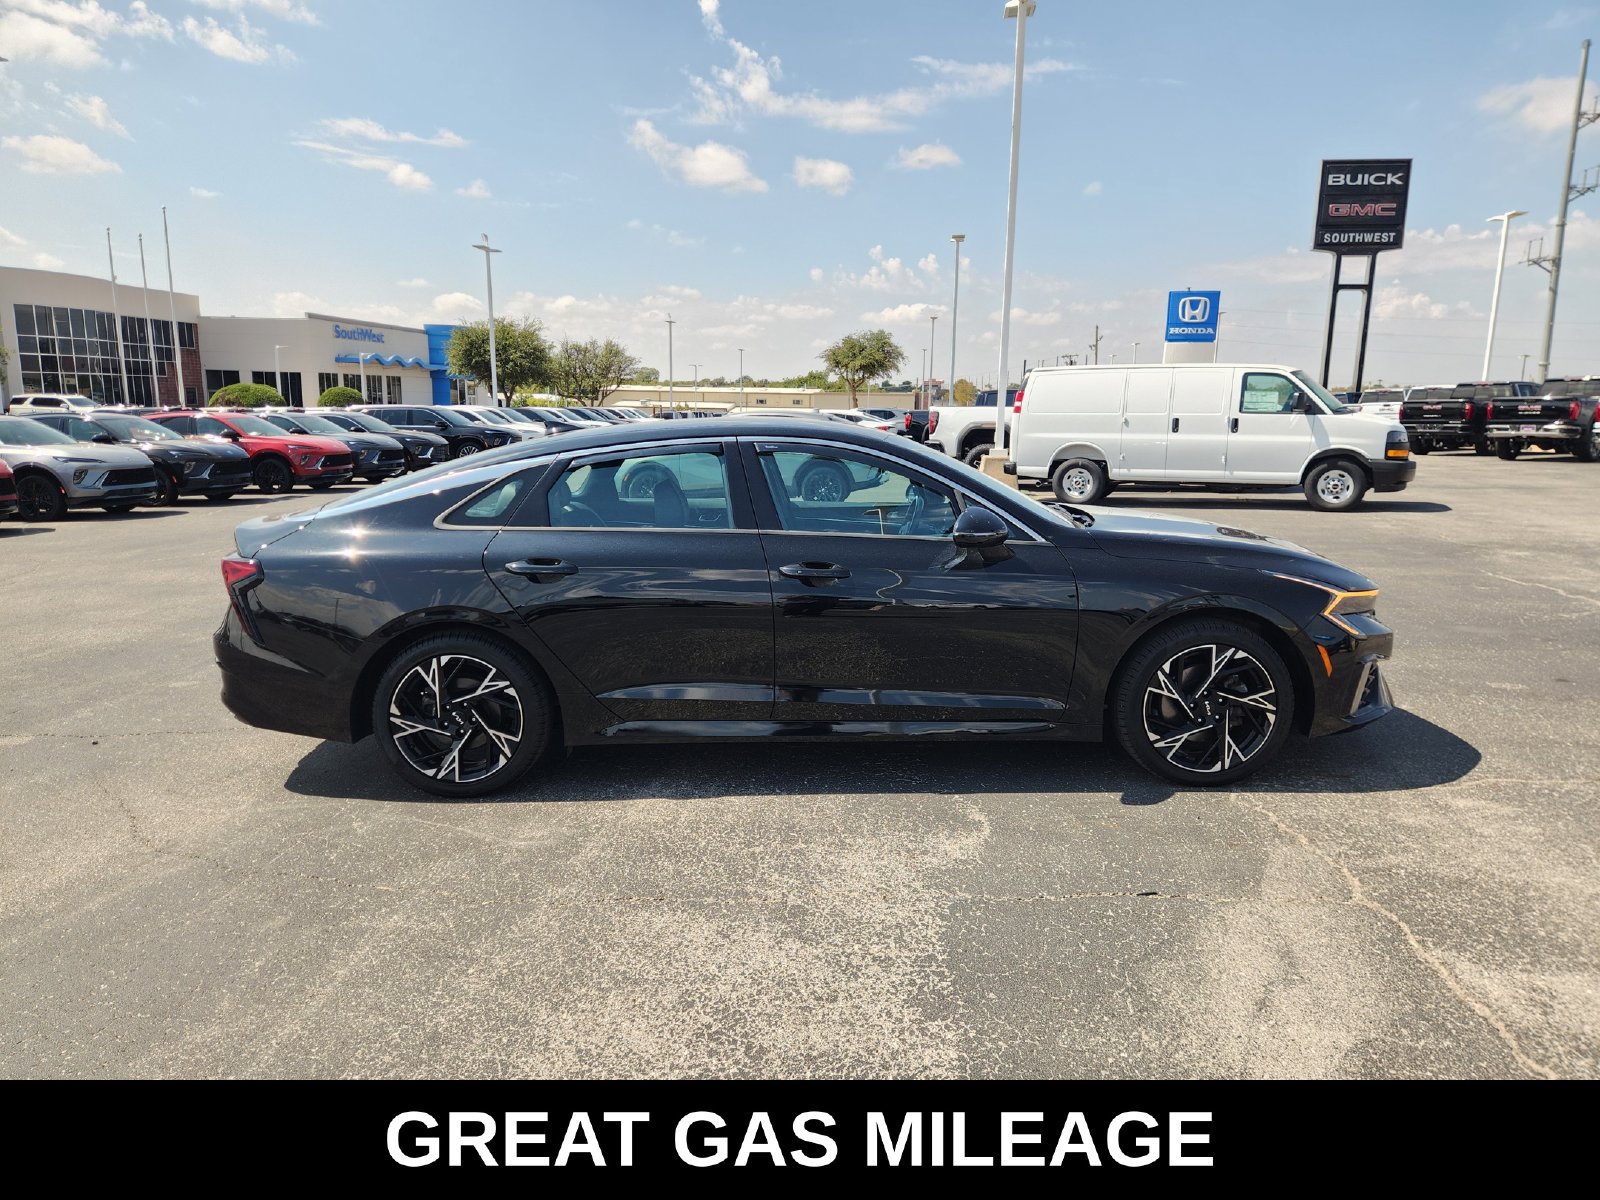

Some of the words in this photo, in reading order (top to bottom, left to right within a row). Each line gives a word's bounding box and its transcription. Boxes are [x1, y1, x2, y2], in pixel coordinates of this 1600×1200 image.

[1327, 173, 1405, 186] BUICK
[1328, 203, 1397, 217] GMC
[1323, 232, 1396, 243] SOUTHWEST
[334, 324, 385, 344] SouthWest
[1168, 327, 1215, 335] HONDA
